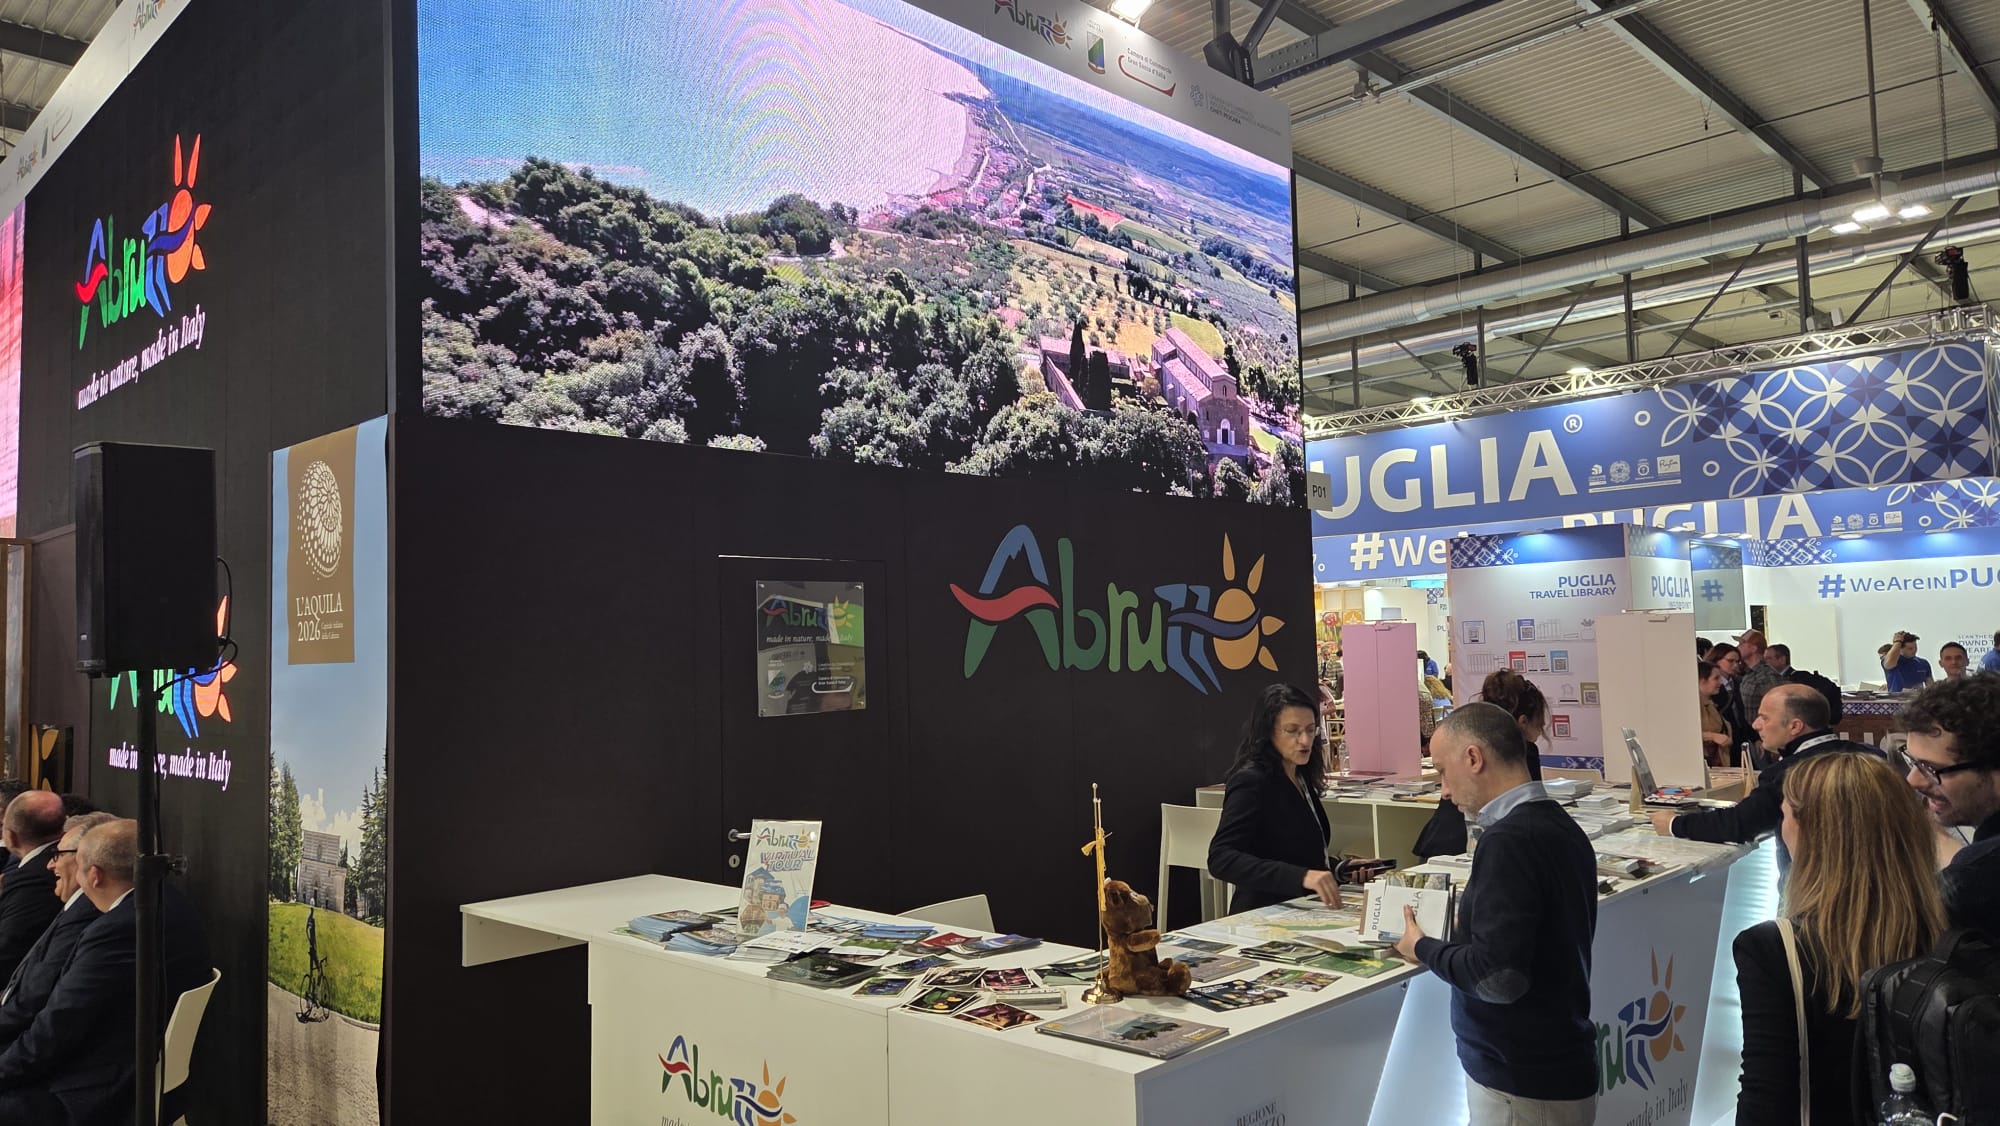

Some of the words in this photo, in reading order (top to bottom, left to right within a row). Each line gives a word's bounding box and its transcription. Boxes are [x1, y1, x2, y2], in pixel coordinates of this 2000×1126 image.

[78, 372, 99, 410] made
[100, 370, 109, 398] in
[110, 355, 139, 383] nature,
[141, 328, 167, 372] made
[168, 325, 179, 356] in
[180, 303, 206, 350] Italy
[1312, 485, 1327, 498] P01
[1559, 574, 1616, 588] PUGLIA
[1651, 576, 1691, 598] PUGLIA
[1529, 589, 1568, 599] TRAVEL
[1571, 587, 1616, 597] LIBRARY
[296, 592, 343, 621] L'AQUILA
[298, 620, 321, 641] 2026
[109, 741, 129, 768] made
[130, 745, 138, 770] in
[169, 747, 194, 777] made
[196, 751, 206, 779] in
[208, 749, 231, 791] Italy
[761, 849, 814, 864] VIRTUAL
[768, 859, 802, 872] TOUR
[1371, 896, 1382, 931] PUGLIA
[1656, 1096, 1665, 1120] in
[1668, 1078, 1688, 1112] Italy
